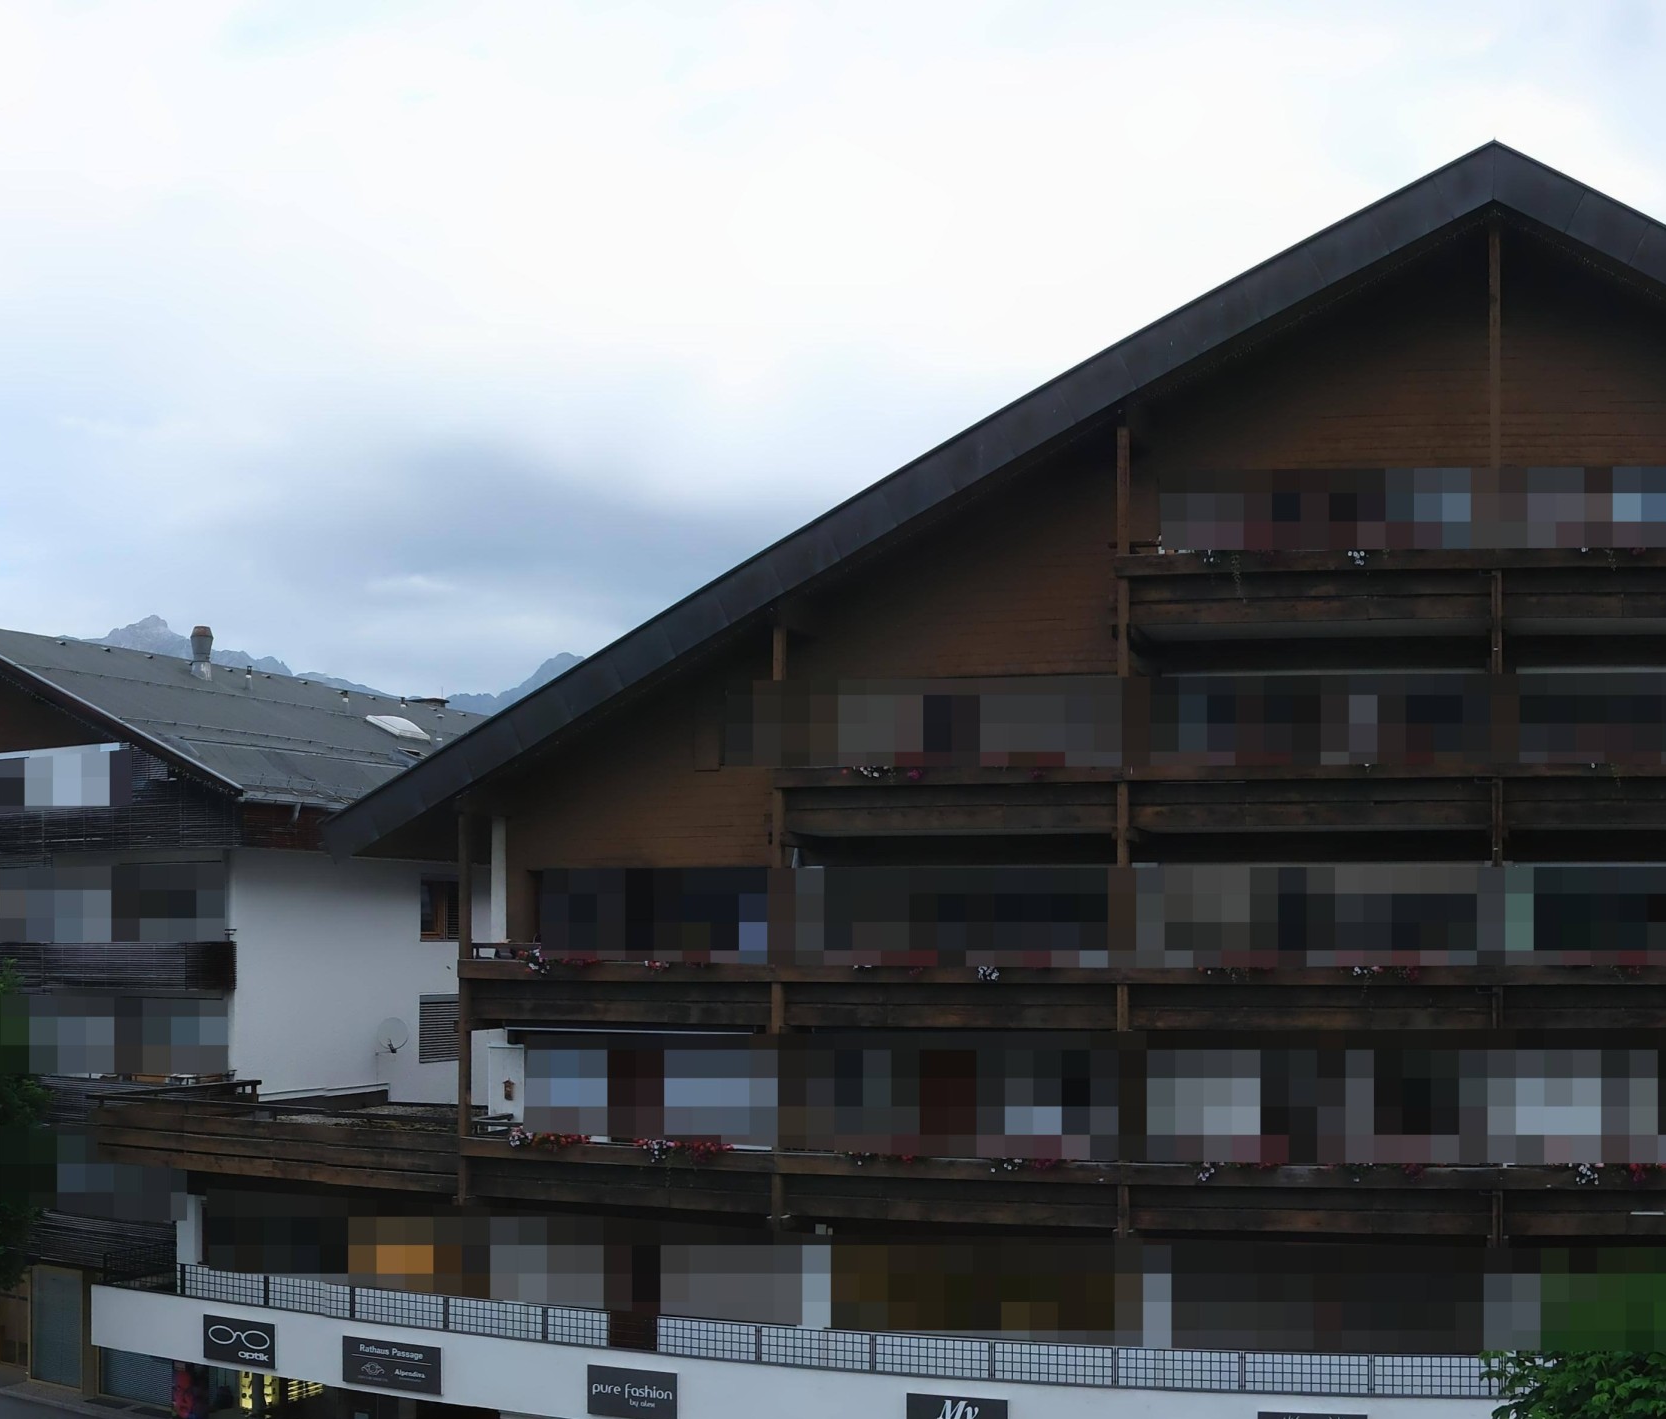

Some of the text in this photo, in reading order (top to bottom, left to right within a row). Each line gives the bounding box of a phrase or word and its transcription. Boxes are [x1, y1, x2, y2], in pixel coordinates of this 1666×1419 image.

[238, 1350, 269, 1362] optik
[359, 1343, 423, 1360] Rathaus Passage
[592, 1382, 673, 1400] pure fashion
